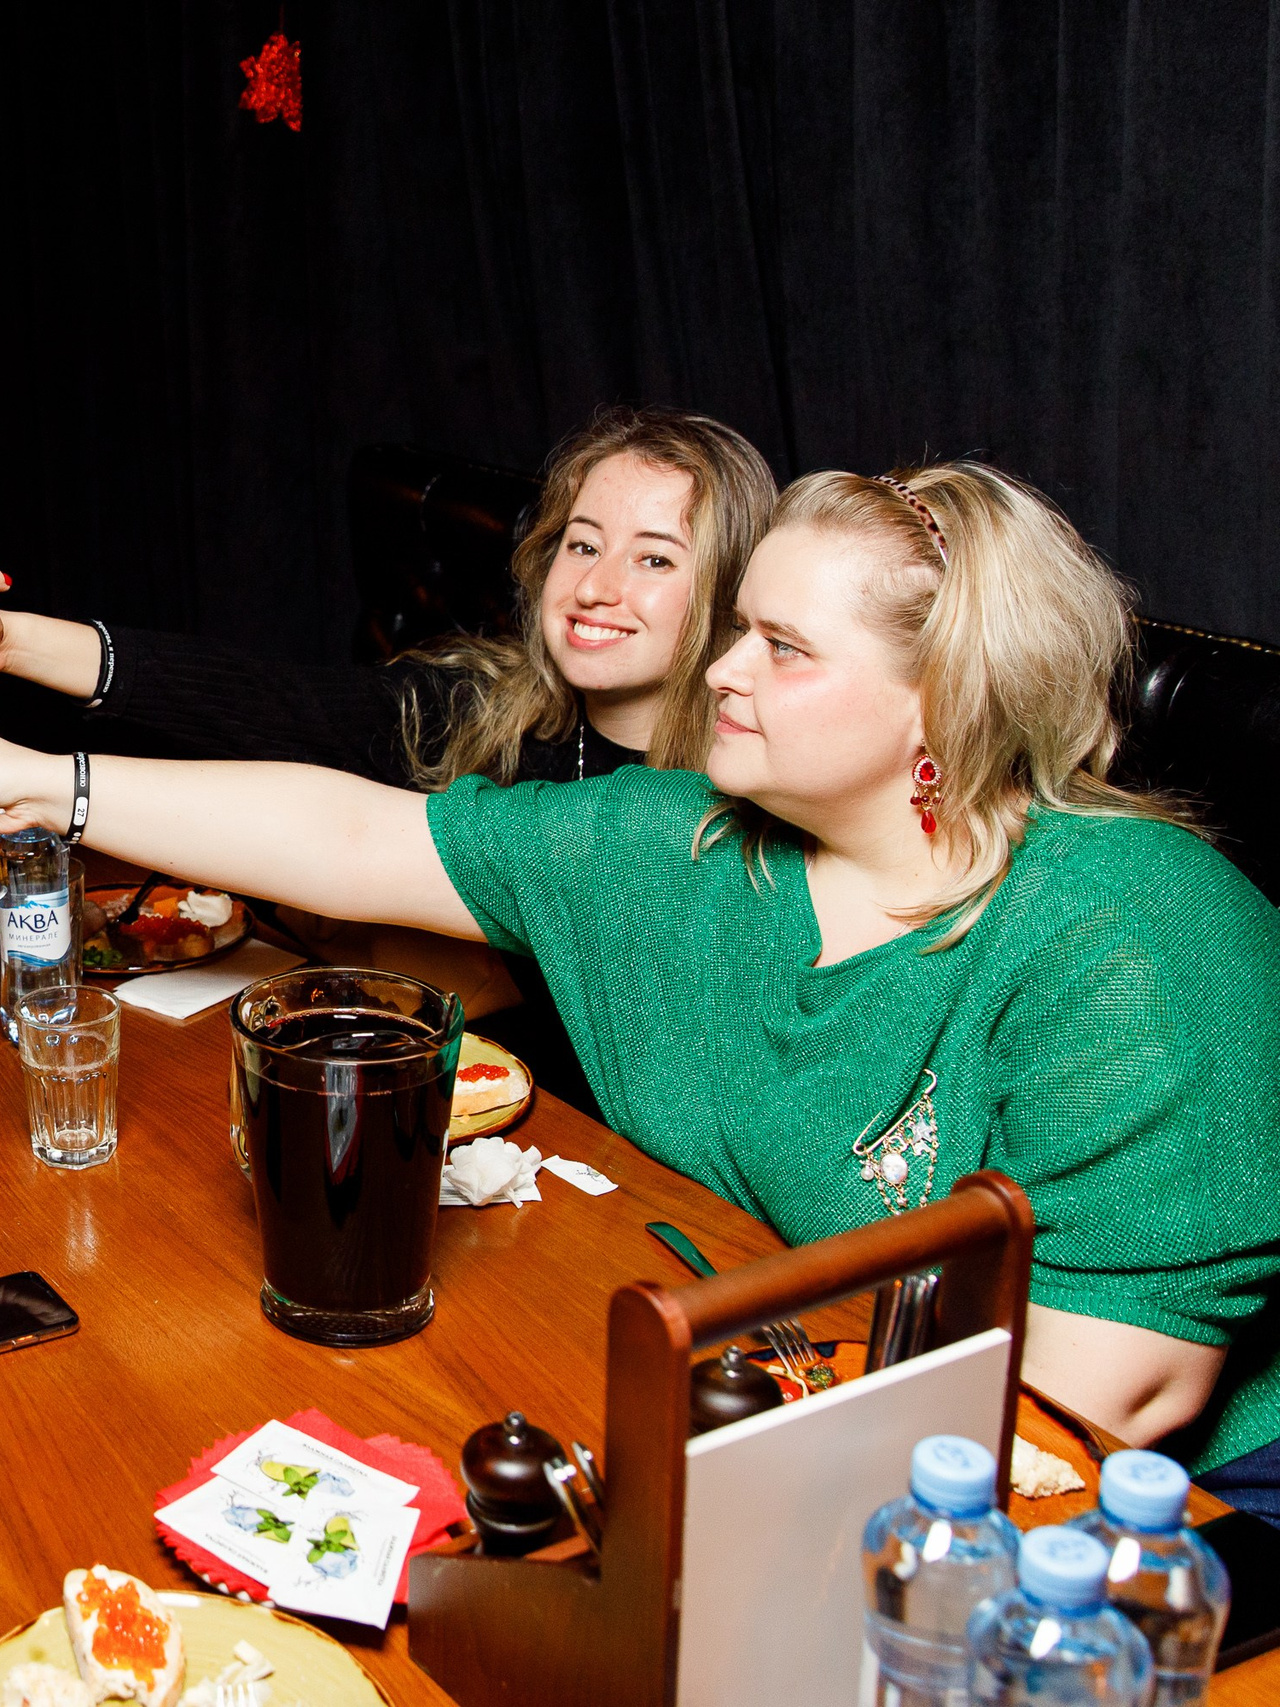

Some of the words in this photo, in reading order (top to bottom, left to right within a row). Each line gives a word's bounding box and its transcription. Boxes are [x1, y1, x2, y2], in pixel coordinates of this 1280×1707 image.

[77, 808, 86, 818] 27
[7, 909, 59, 934] АКВА
[8, 931, 58, 942] МИНЕРАЛЕ
